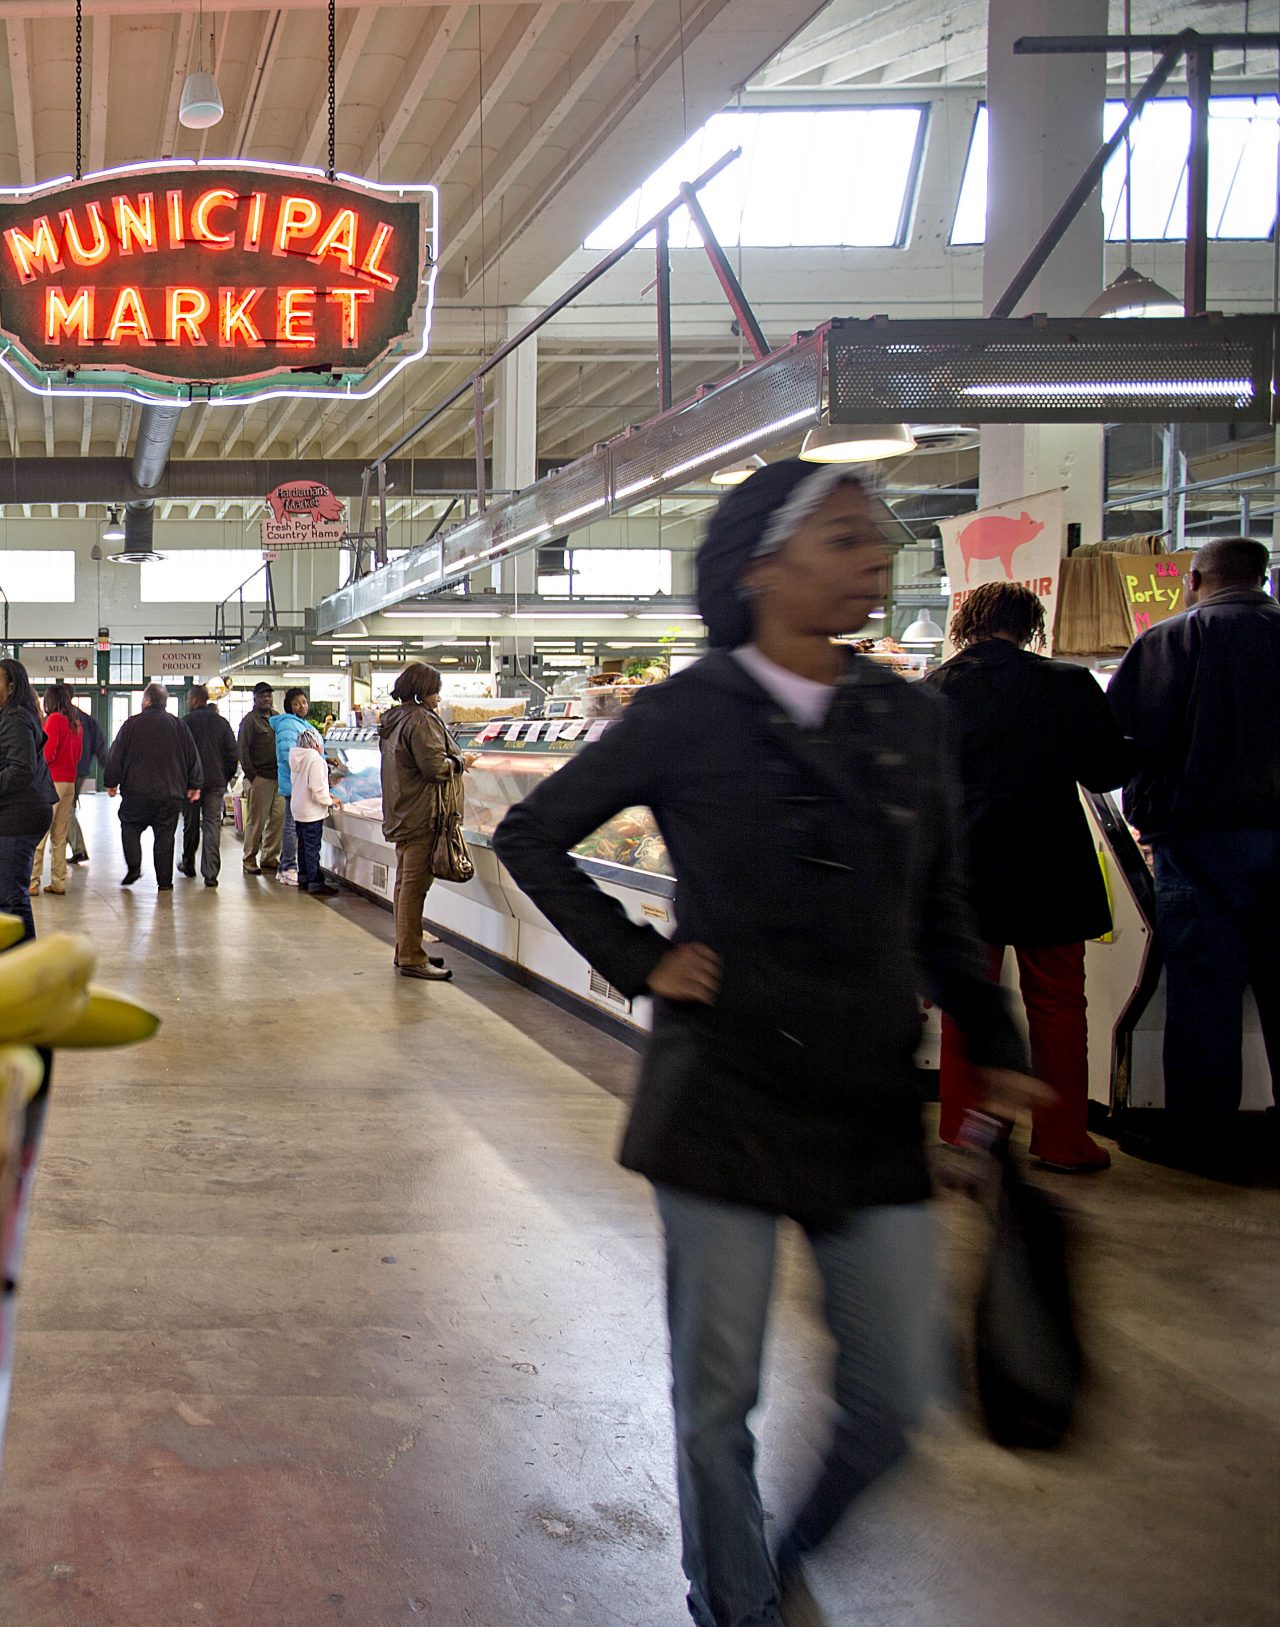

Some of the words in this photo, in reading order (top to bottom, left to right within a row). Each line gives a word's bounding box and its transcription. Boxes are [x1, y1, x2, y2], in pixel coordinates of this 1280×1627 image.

[4, 189, 399, 291] MUNICIPAL
[44, 285, 374, 348] MARKET
[285, 496, 319, 511] Market
[266, 522, 291, 532] Fresh
[295, 521, 317, 531] Pork
[267, 531, 307, 541] Country
[312, 530, 339, 539] Hams
[1126, 574, 1180, 610] Porky
[44, 655, 69, 663] AREPA
[162, 653, 202, 661] COUNTRY
[49, 664, 65, 672] MIA
[162, 662, 202, 671] PRODUCE
